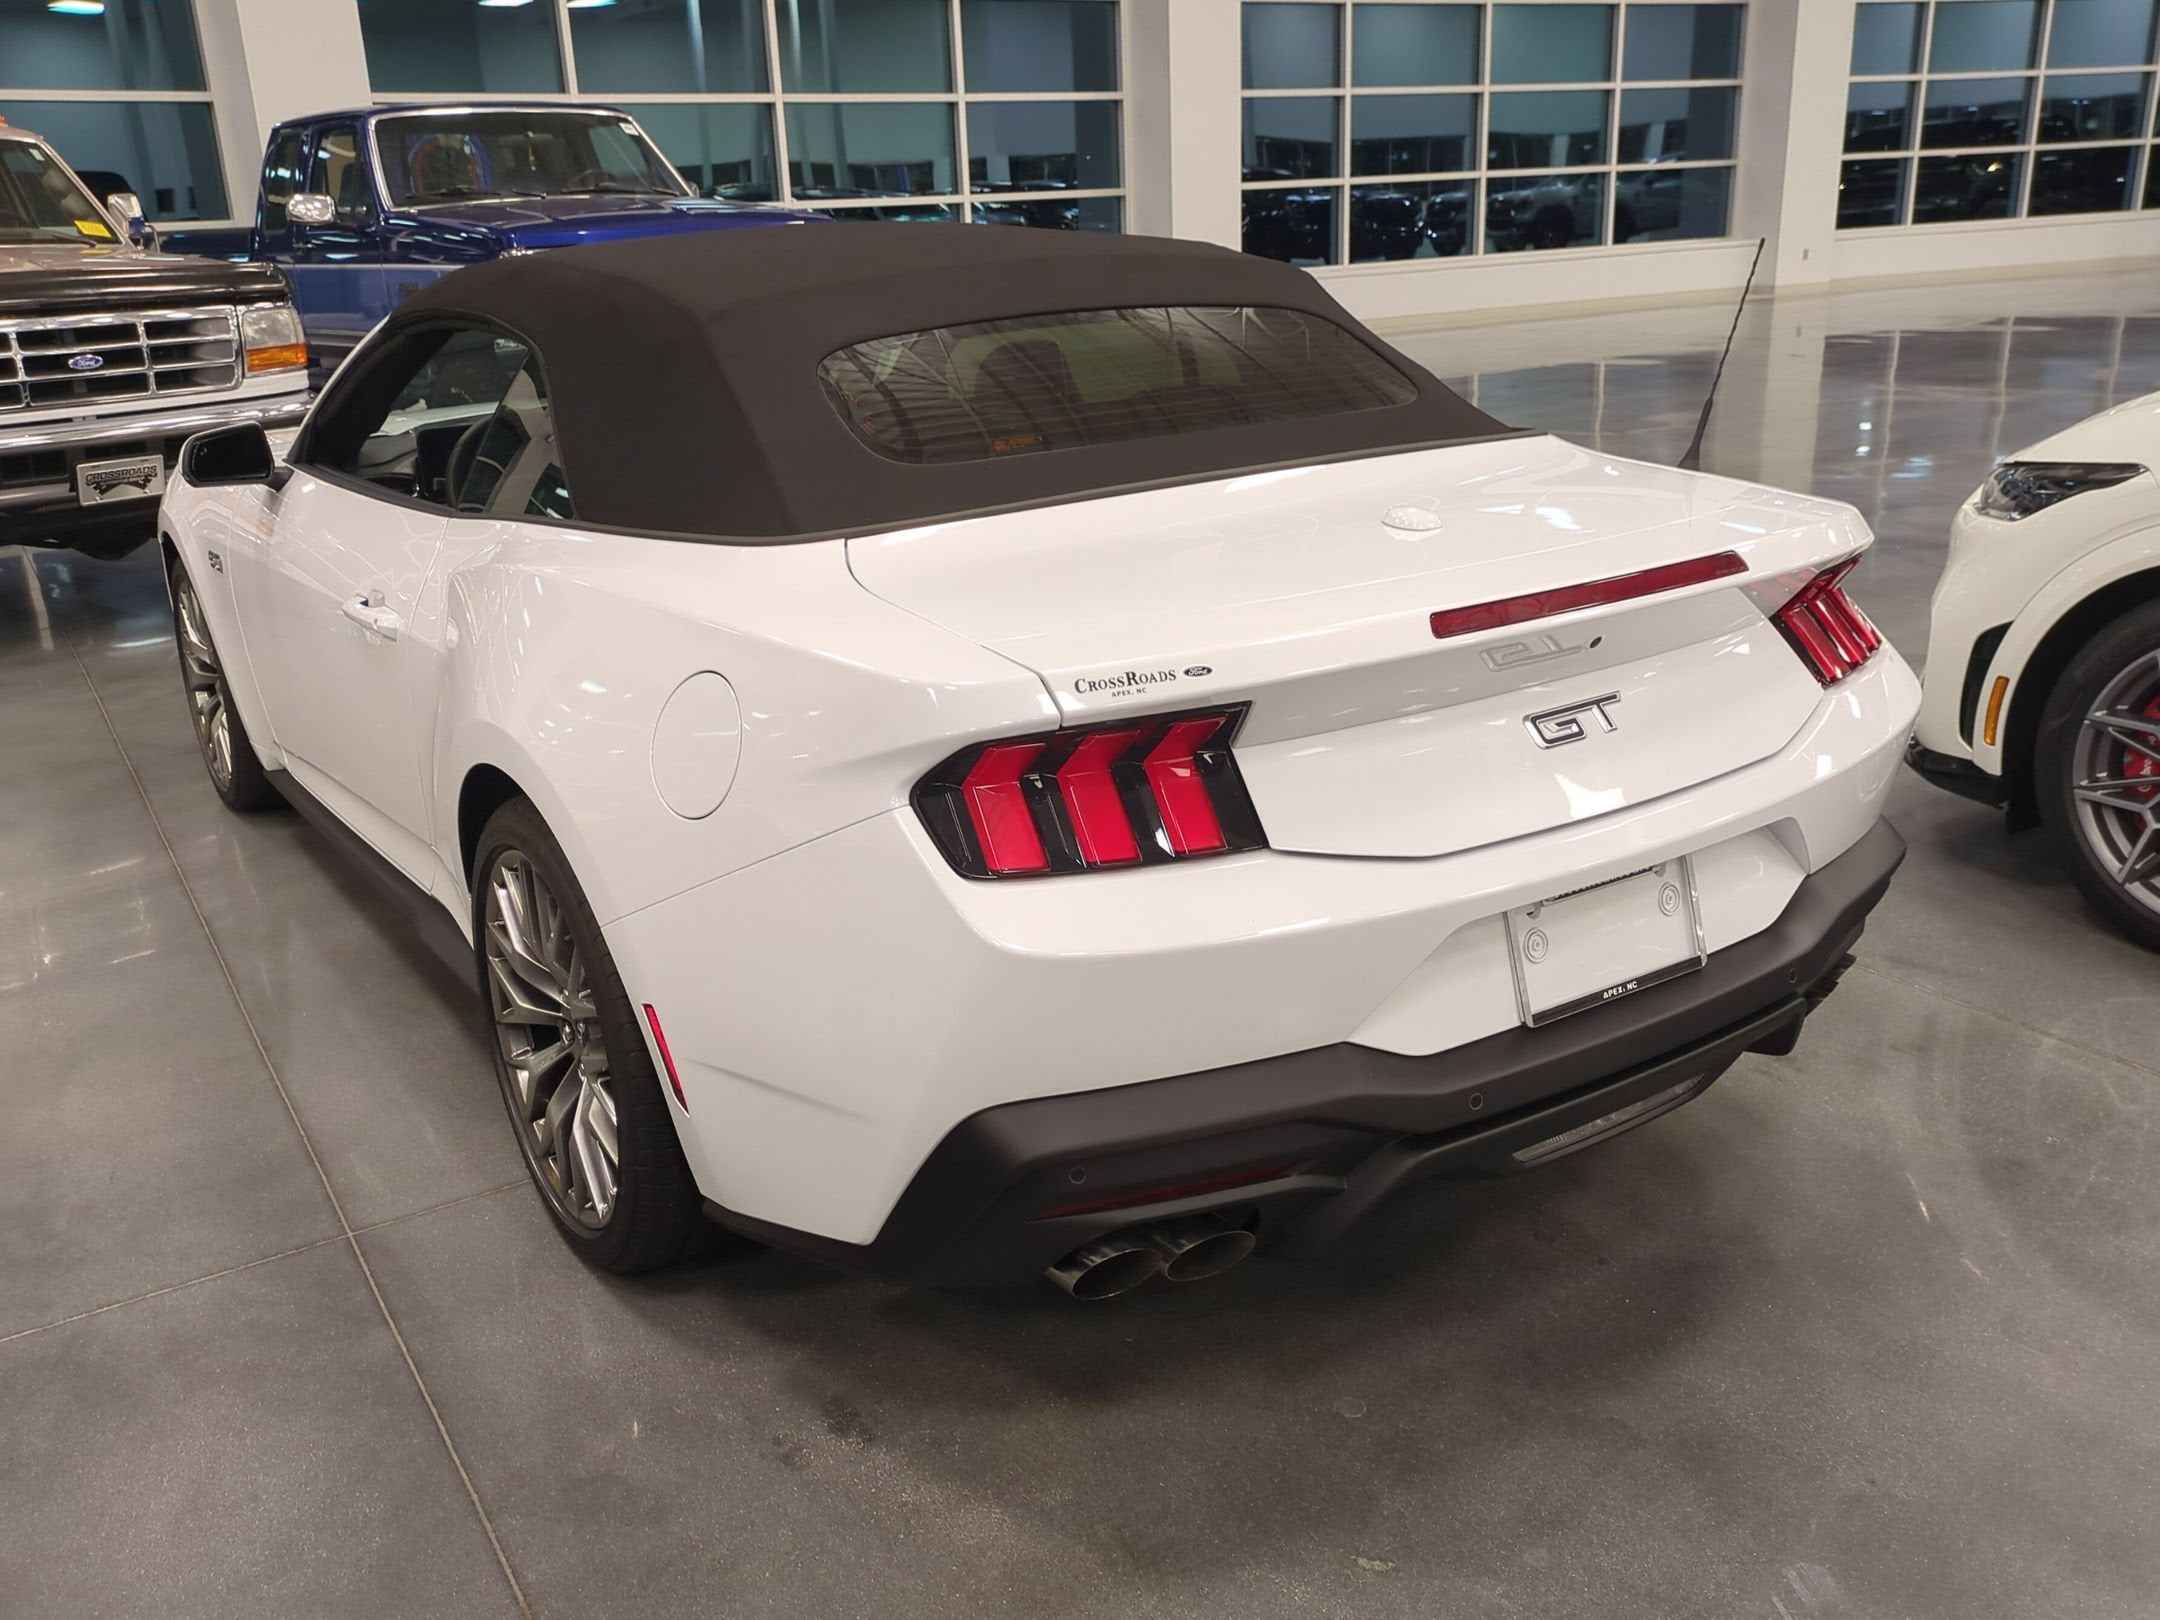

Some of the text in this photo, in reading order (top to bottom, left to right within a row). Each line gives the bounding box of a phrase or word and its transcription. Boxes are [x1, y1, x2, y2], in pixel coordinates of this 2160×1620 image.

[85, 464, 158, 482] CROSSROADS
[1111, 686, 1147, 698] APEX, NC
[1522, 690, 1621, 750] GT
[1603, 980, 1638, 999] APEX, NC
